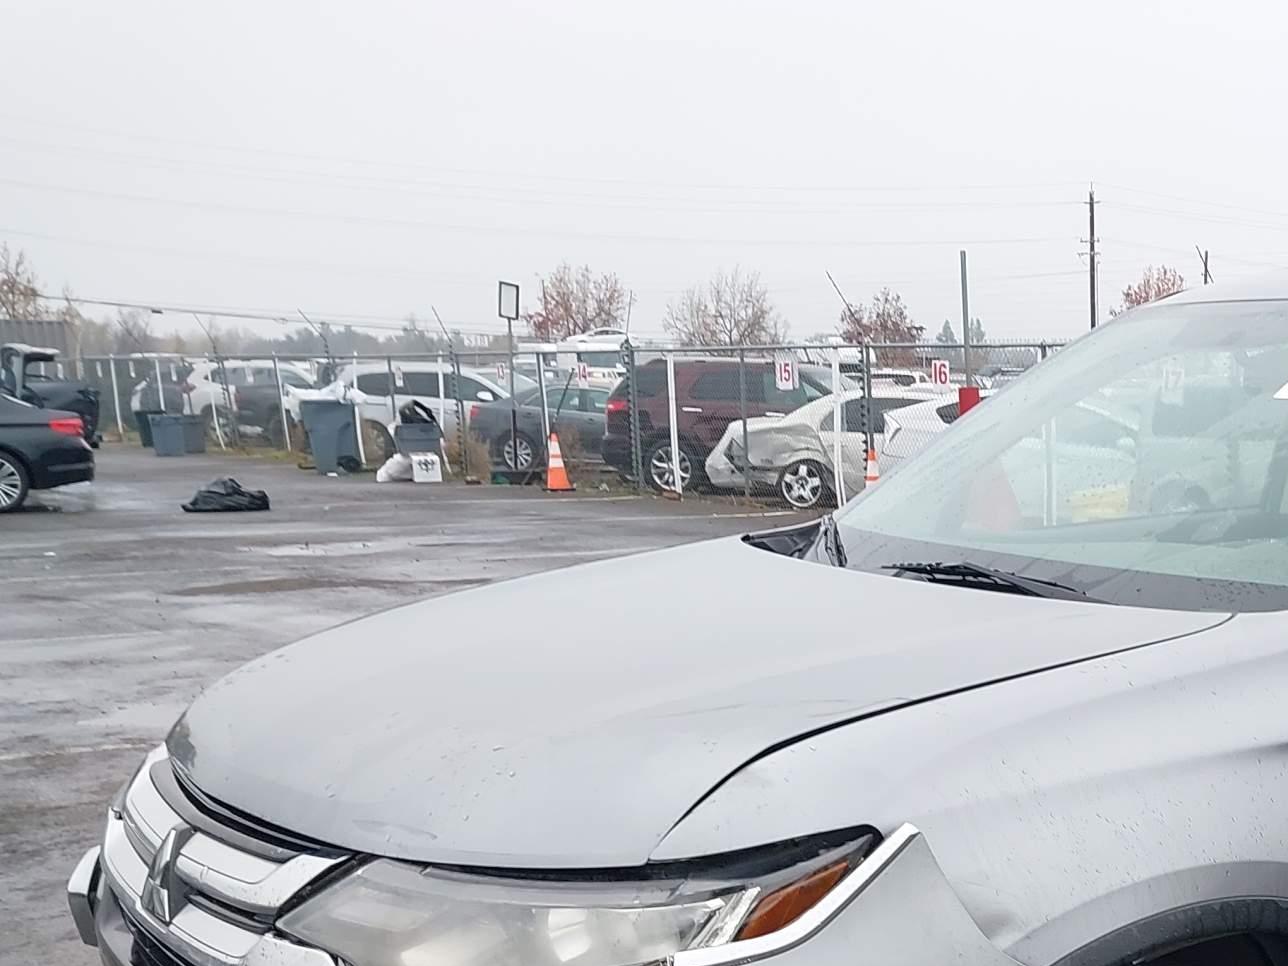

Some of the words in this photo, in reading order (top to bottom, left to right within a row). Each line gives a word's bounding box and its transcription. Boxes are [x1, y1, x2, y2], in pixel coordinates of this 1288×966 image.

[577, 364, 587, 381] 14
[779, 363, 791, 383] 15
[933, 363, 947, 384] 16
